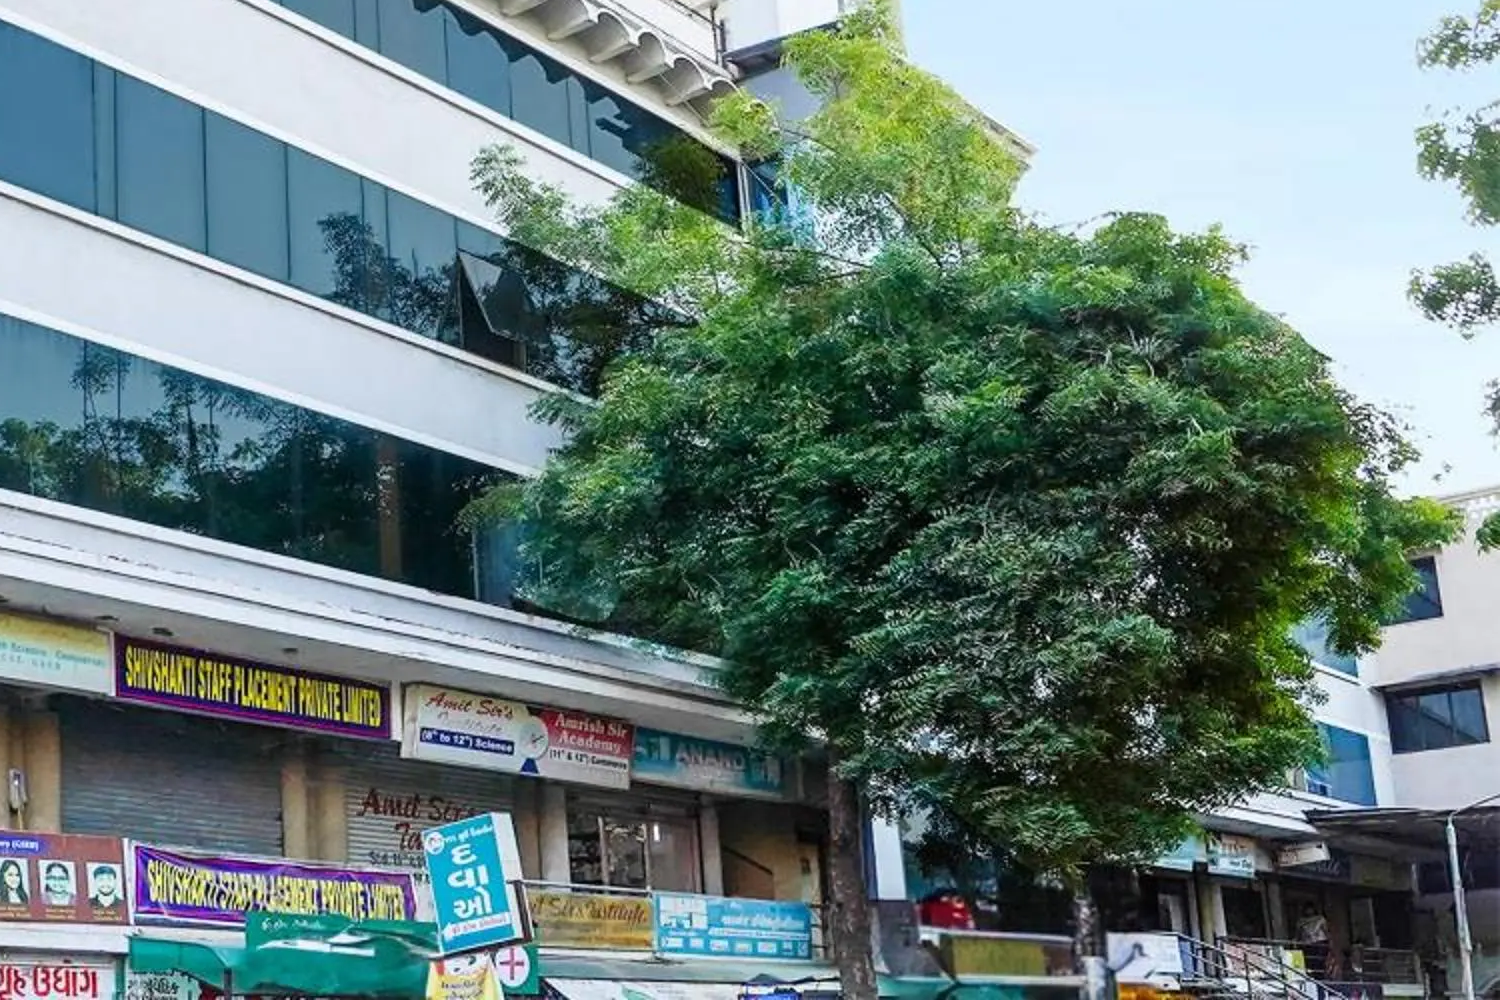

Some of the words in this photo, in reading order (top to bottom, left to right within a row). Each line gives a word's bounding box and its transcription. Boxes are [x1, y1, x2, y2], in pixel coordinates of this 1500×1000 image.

[125, 644, 197, 698] SHIVSHAKTI
[197, 657, 231, 703] STAFF
[233, 664, 297, 714] PLACEMENT
[298, 676, 341, 721] PRIVATE
[341, 684, 382, 728] LIMITED
[555, 713, 607, 735] Amrish
[608, 722, 628, 739] Sir
[439, 732, 452, 743] to
[475, 737, 513, 754] Science
[558, 731, 622, 754] Academy
